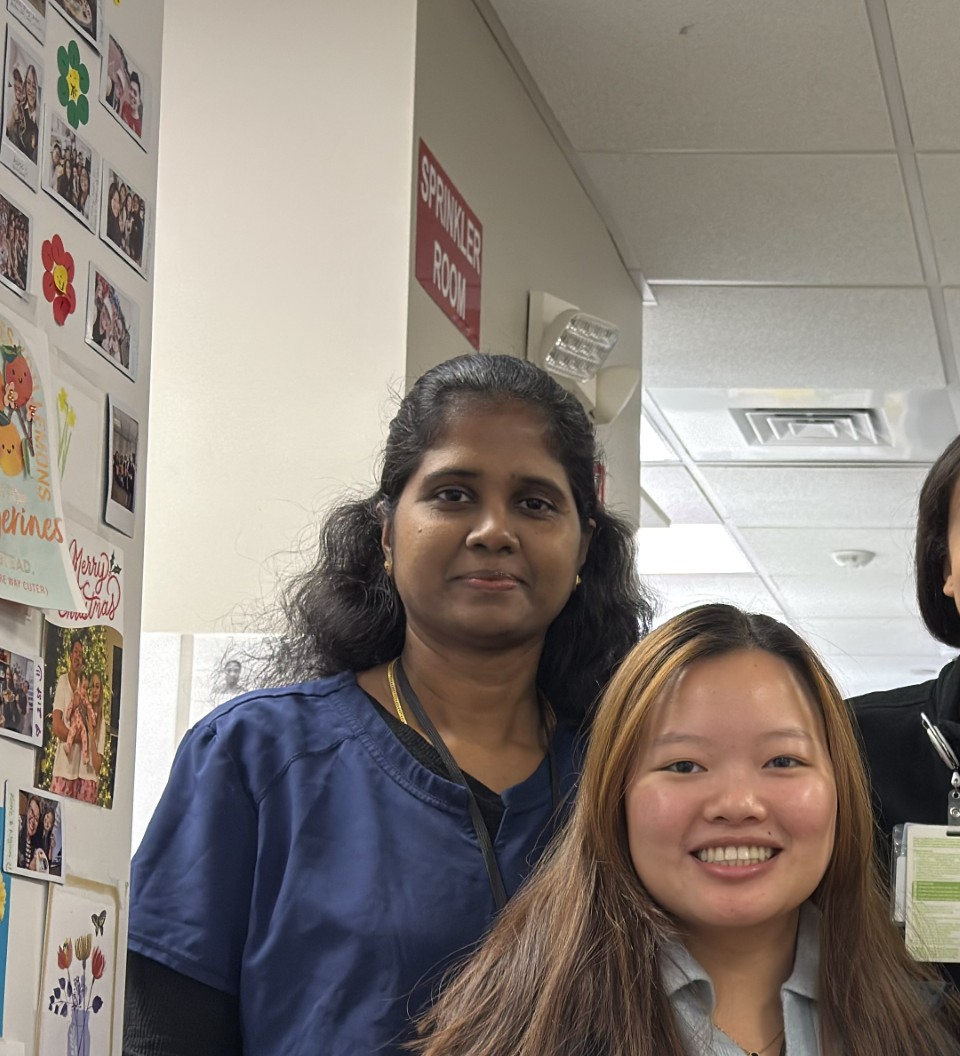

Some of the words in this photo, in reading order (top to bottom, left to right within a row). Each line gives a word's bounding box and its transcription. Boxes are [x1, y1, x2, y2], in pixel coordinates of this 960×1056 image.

[421, 155, 481, 274] SPRINKLER
[433, 240, 467, 321] ROOM
[0, 506, 63, 543] erines
[69, 539, 110, 594] Merry
